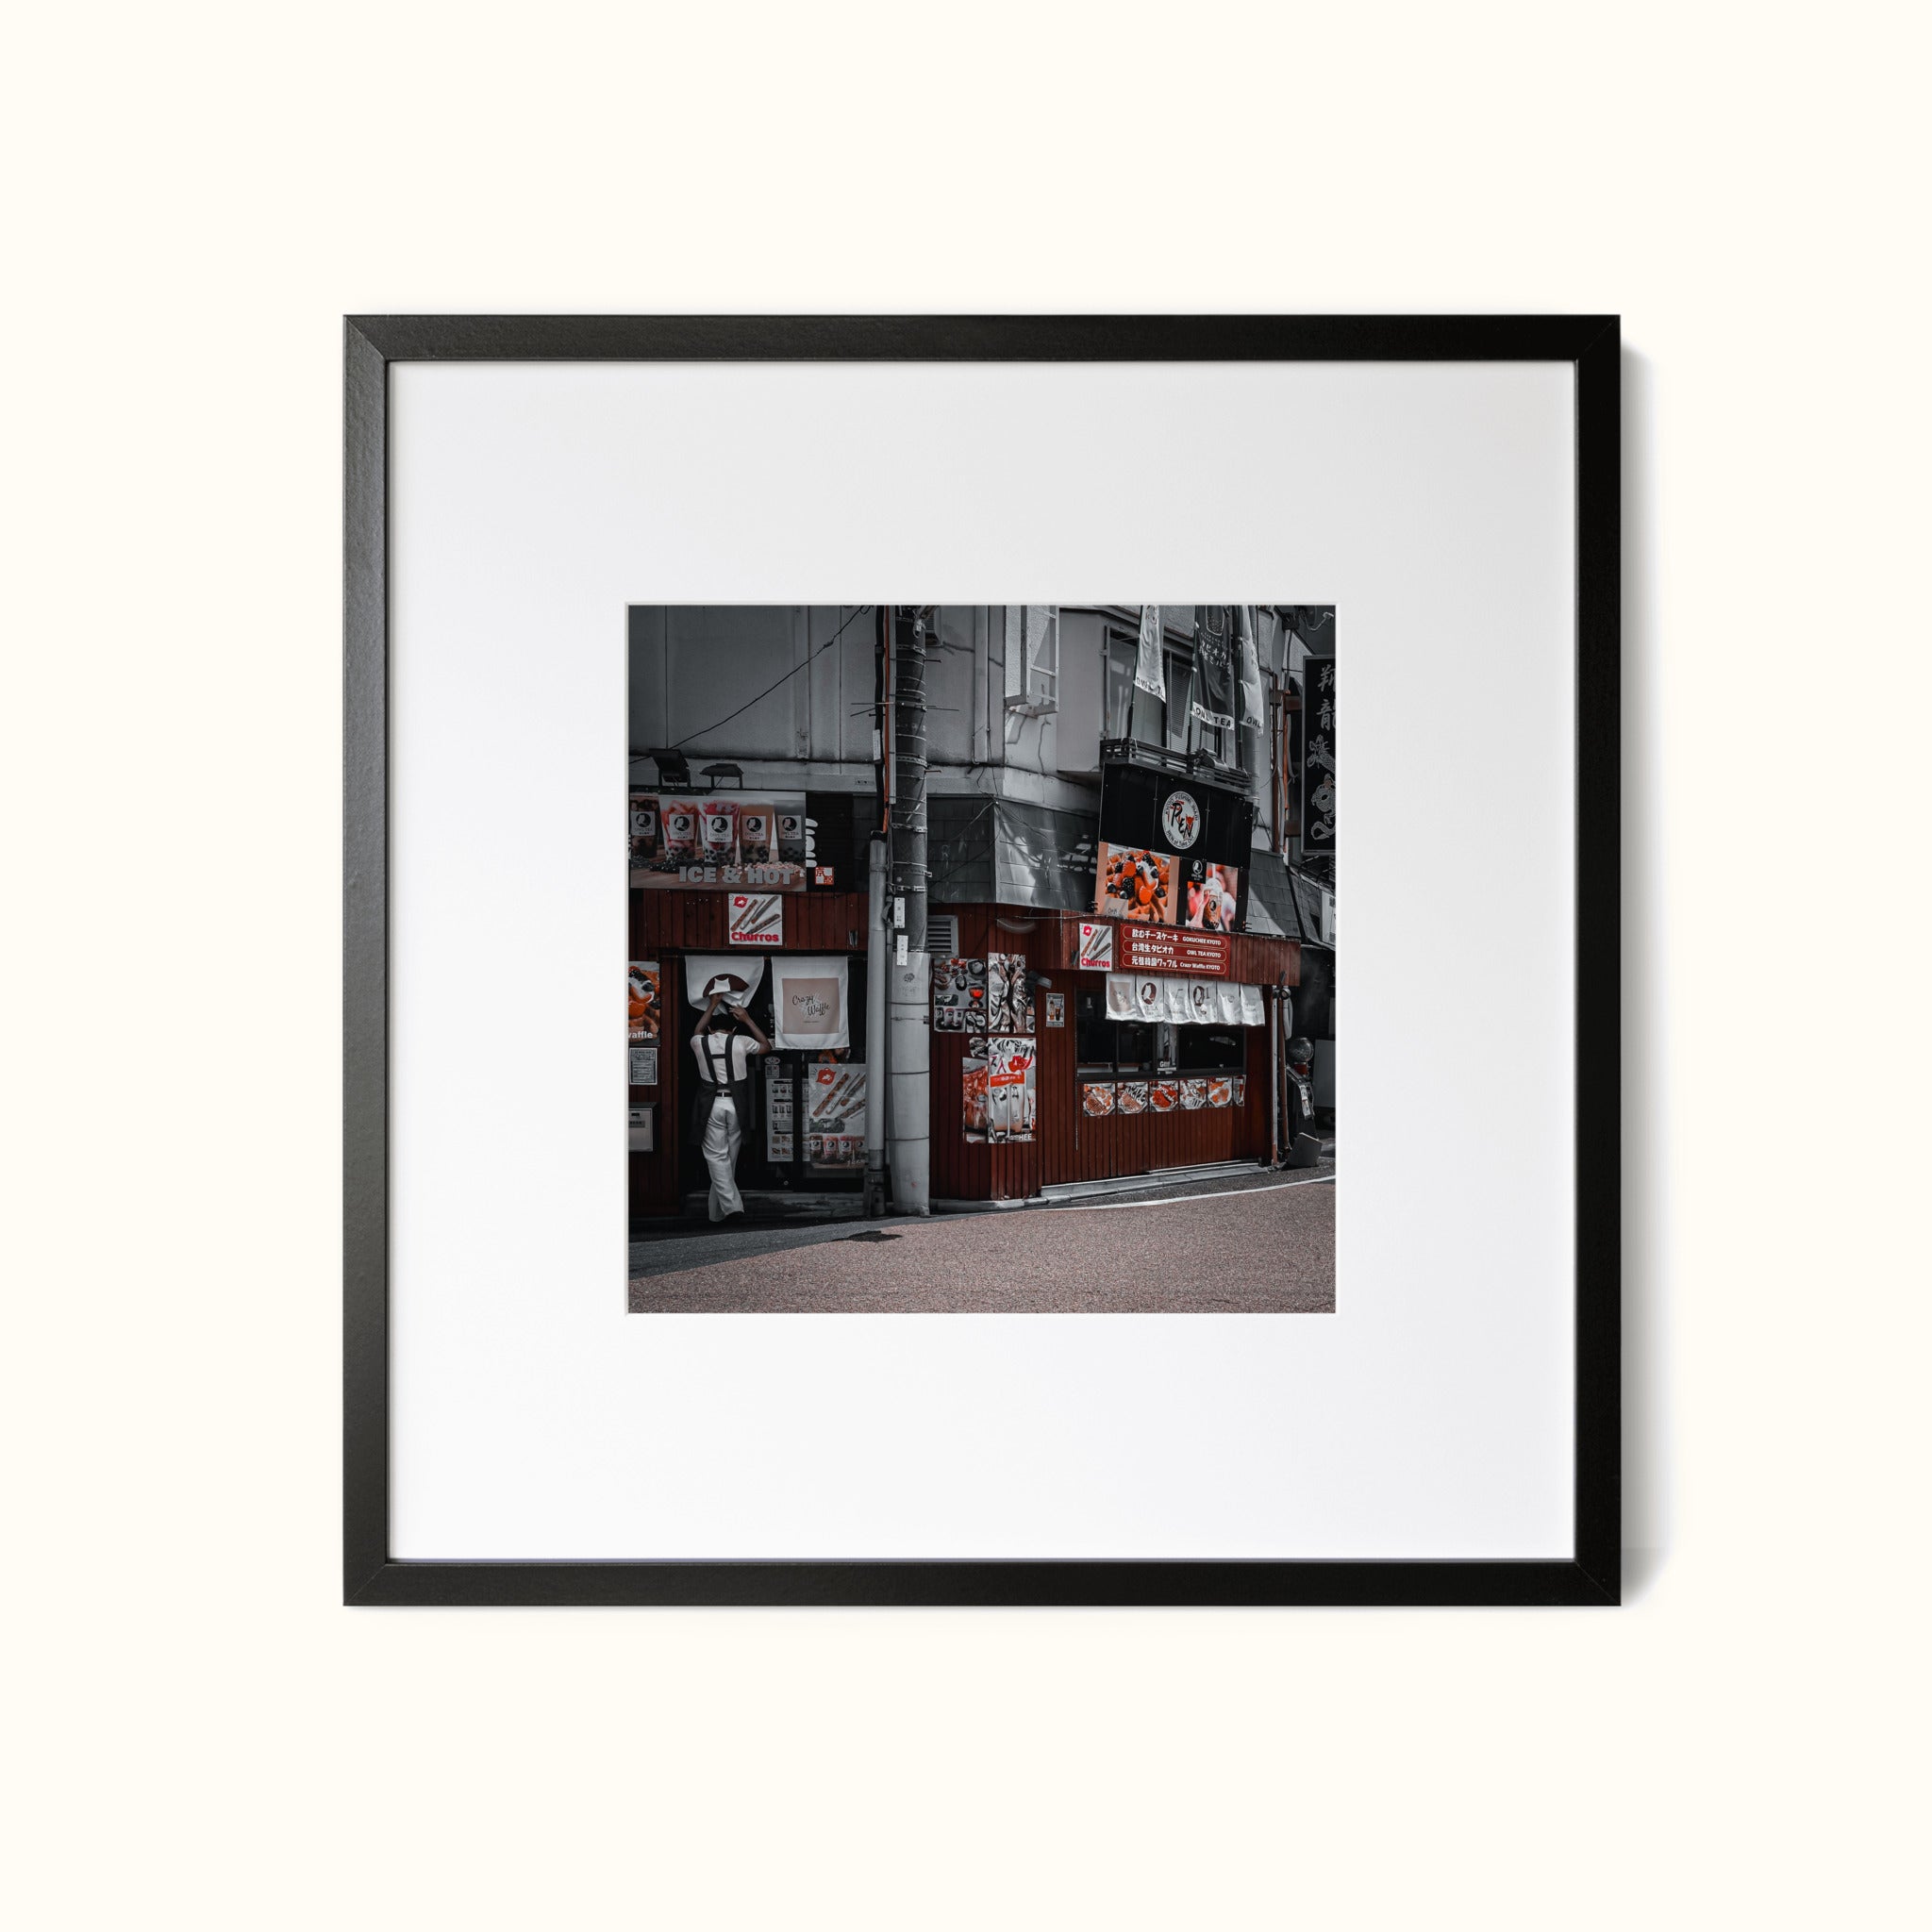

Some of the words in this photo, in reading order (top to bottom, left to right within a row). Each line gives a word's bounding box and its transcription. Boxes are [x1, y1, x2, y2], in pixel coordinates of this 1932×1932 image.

[1213, 716, 1231, 727] TEA
[1246, 716, 1261, 729] OWL
[679, 867, 717, 883] ICE
[722, 868, 741, 884] &
[747, 868, 795, 885] HOT
[731, 932, 779, 942] Churros
[1081, 958, 1110, 968] Churros
[792, 994, 814, 1006] Crazy
[808, 1002, 830, 1016] Waffle
